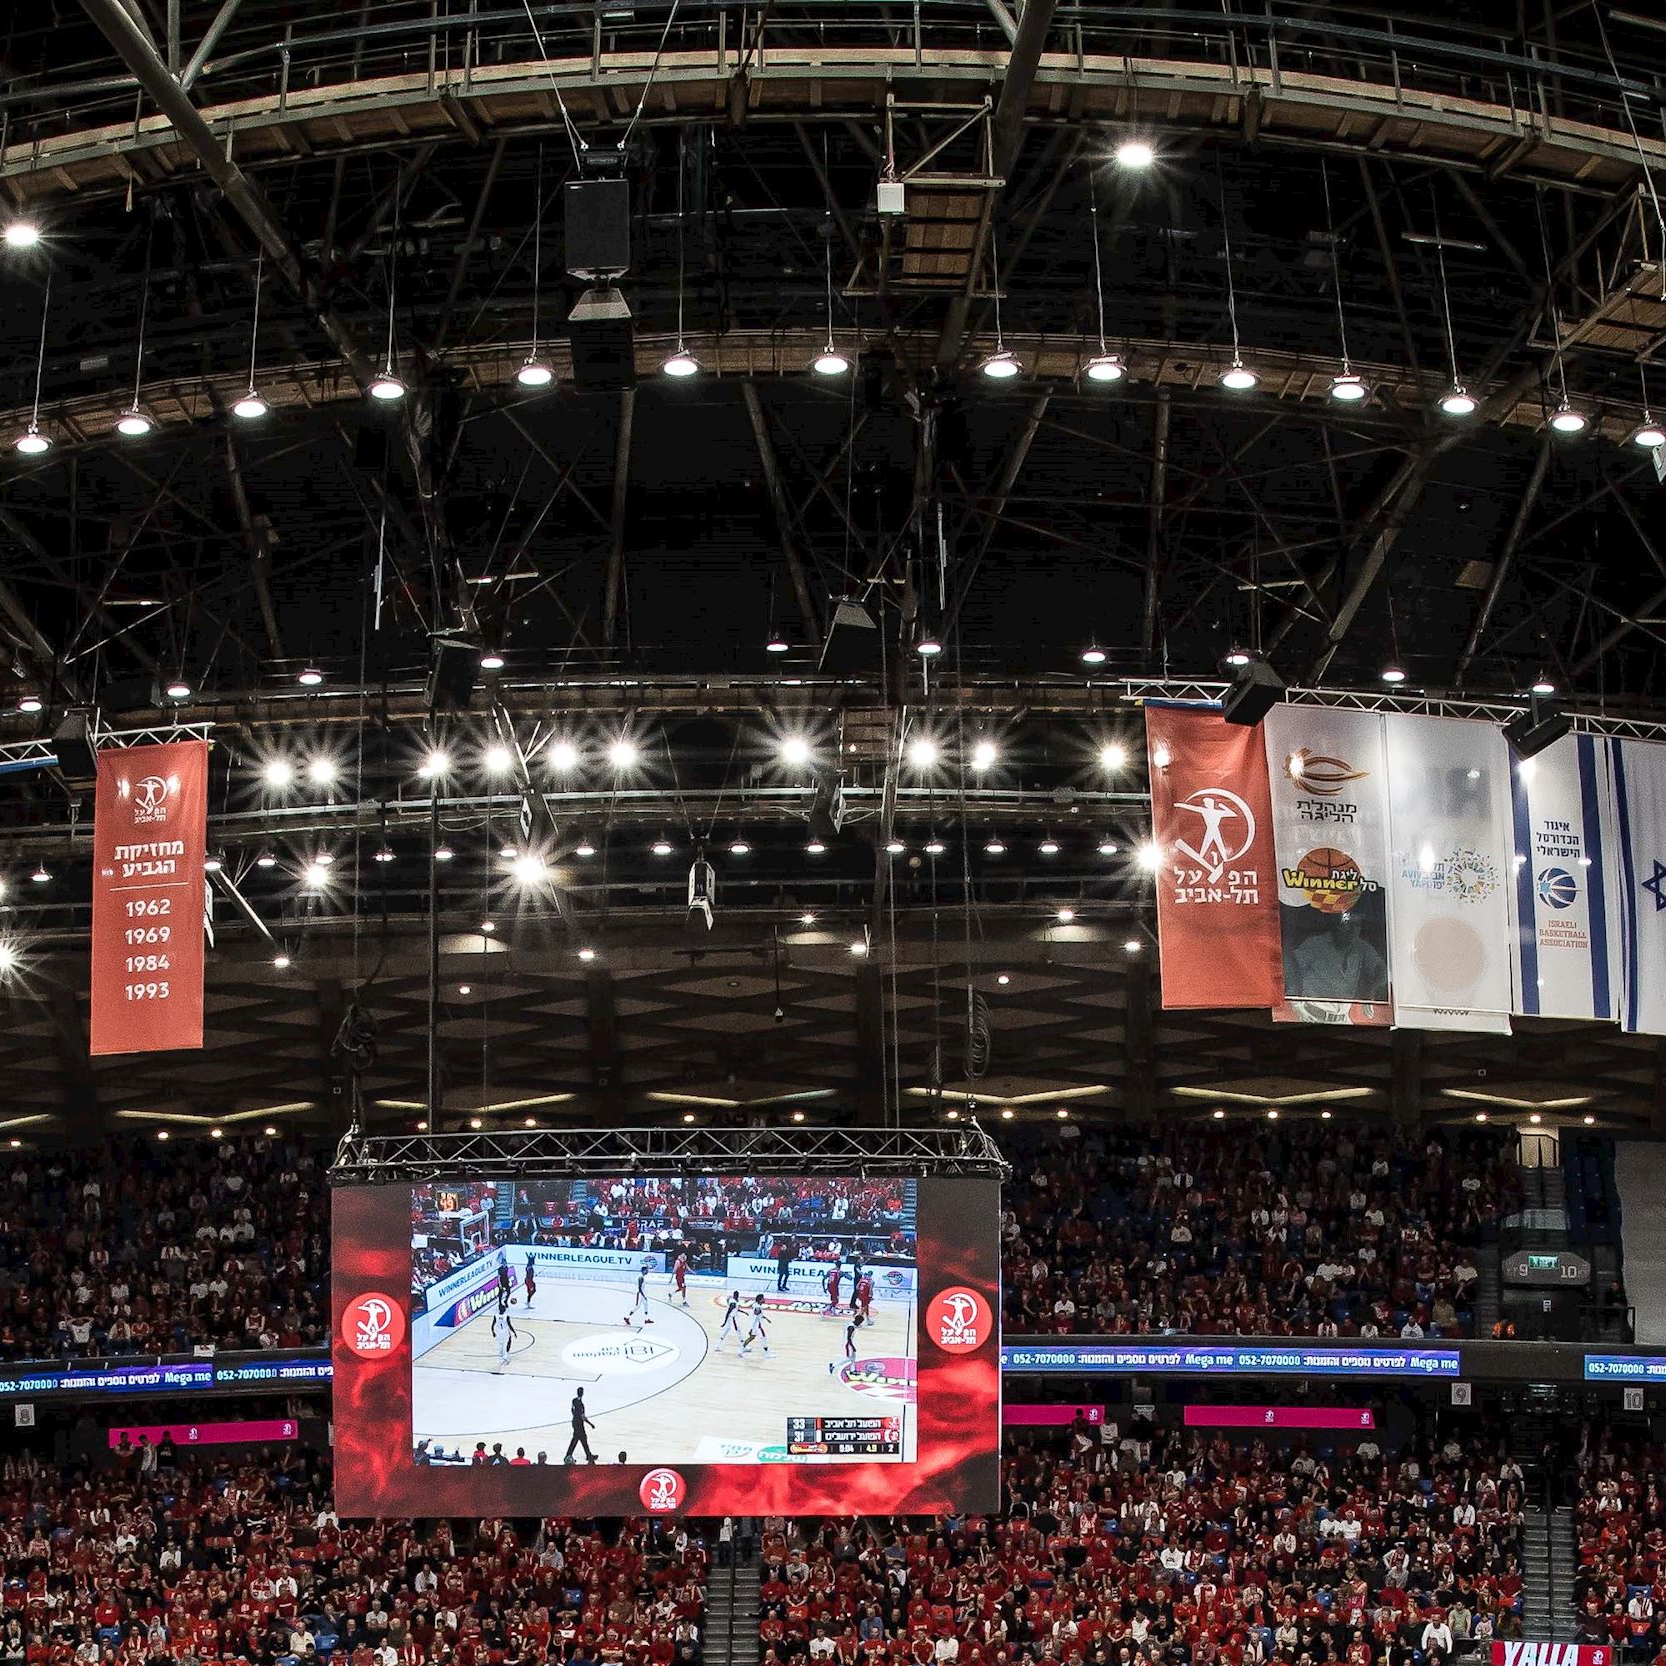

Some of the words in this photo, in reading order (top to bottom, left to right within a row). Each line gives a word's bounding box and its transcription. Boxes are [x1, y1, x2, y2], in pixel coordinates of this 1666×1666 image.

[1296, 799, 1357, 813] מנהלת
[1301, 810, 1354, 823] הליגה
[1544, 820, 1570, 831] איגוד
[1536, 832, 1580, 845] הכדורסל
[114, 840, 185, 860] מחזיקת
[1536, 845, 1581, 858] הישראלי
[122, 859, 176, 878] הגביע
[1331, 868, 1358, 880] ליגת
[1283, 868, 1359, 891] Winner
[1360, 877, 1377, 892] סל
[1174, 886, 1259, 904] תל-אביב
[125, 899, 171, 918] 1962
[1548, 919, 1577, 929] ISRAELI
[125, 926, 171, 945] 1969
[1539, 929, 1587, 940] BASKETBALL
[1539, 938, 1588, 949] ASSOCIATION
[125, 954, 171, 973] 1984
[125, 981, 170, 1001] 1993
[525, 1251, 632, 1265] WINNERLEAGUE.TV
[1519, 1264, 1528, 1277] 9
[1561, 1265, 1578, 1278] 10
[438, 1260, 493, 1298] WINNERLEAGUE.TV
[1013, 1354, 1075, 1365] 052-7070000
[1185, 1353, 1214, 1368] Mega
[1216, 1356, 1233, 1365] me
[1239, 1355, 1301, 1366] 052-7070000
[1410, 1357, 1439, 1371] Mega
[1441, 1360, 1458, 1369] me
[1589, 1363, 1644, 1374] 052-7070000
[165, 1371, 193, 1386] Mega
[195, 1372, 212, 1382] me
[1455, 1387, 1467, 1402] 9
[1625, 1391, 1642, 1408] 10
[792, 1419, 805, 1430] 33
[794, 1431, 805, 1442] 31
